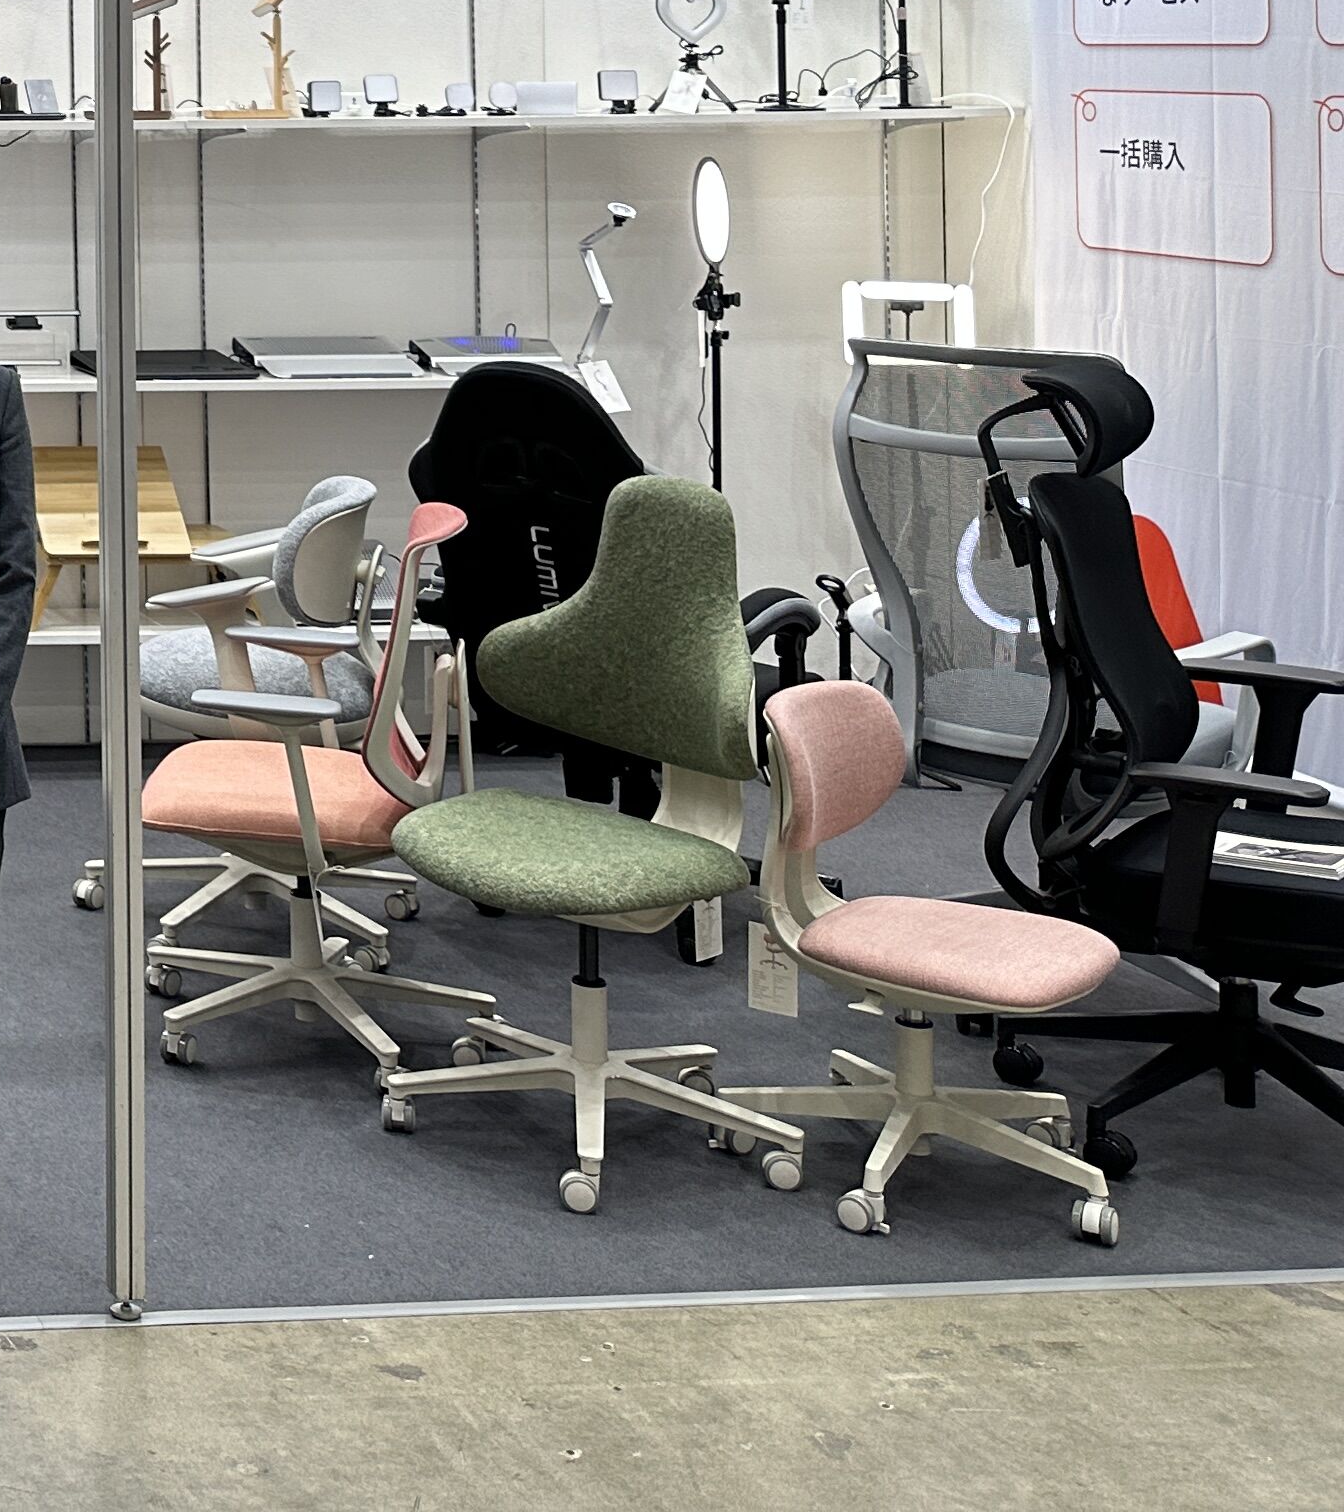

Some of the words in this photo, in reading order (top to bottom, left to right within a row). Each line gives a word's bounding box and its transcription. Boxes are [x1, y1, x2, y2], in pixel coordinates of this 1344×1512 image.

[1099, 138, 1185, 171] 一括購入
[530, 525, 561, 610] LUMIV
